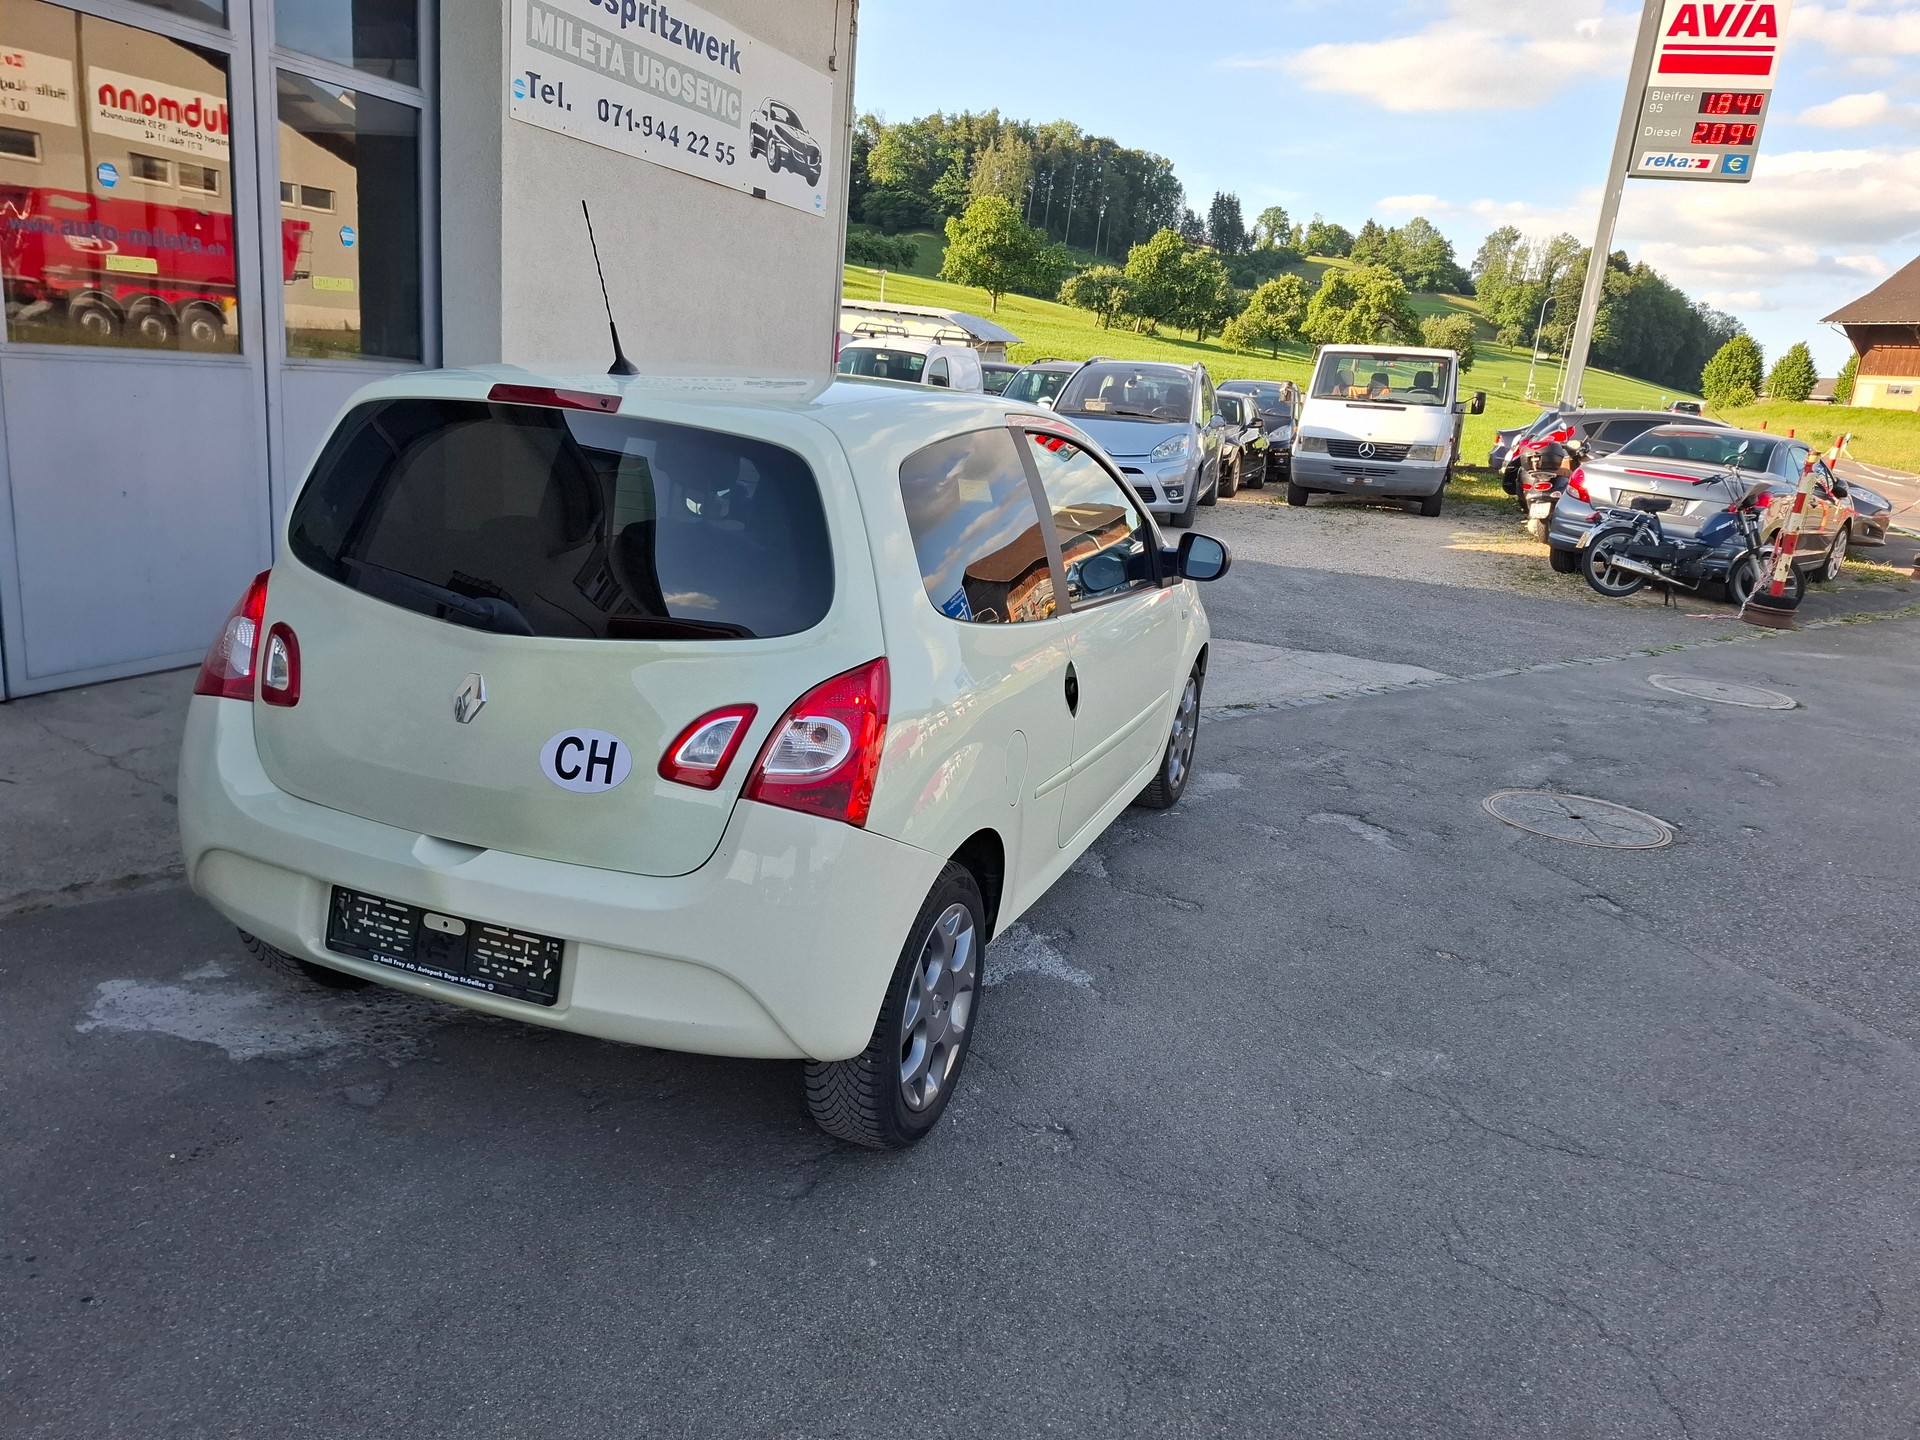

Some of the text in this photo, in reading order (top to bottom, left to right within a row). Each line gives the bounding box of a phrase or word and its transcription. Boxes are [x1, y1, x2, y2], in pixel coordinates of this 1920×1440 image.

[1666, 3, 1778, 38] AVIA
[531, 6, 740, 122] MILETA UROSEVIC
[525, 70, 572, 112] Tel.
[597, 98, 680, 148] 071-944
[686, 130, 710, 159] 22
[714, 141, 736, 166] 55
[1649, 91, 1695, 113] Bleifrei 95
[1644, 126, 1682, 138] Diesel
[554, 736, 618, 785] CH
[380, 955, 393, 964] Emil
[393, 959, 405, 968] Frey
[418, 966, 443, 977] Autopark
